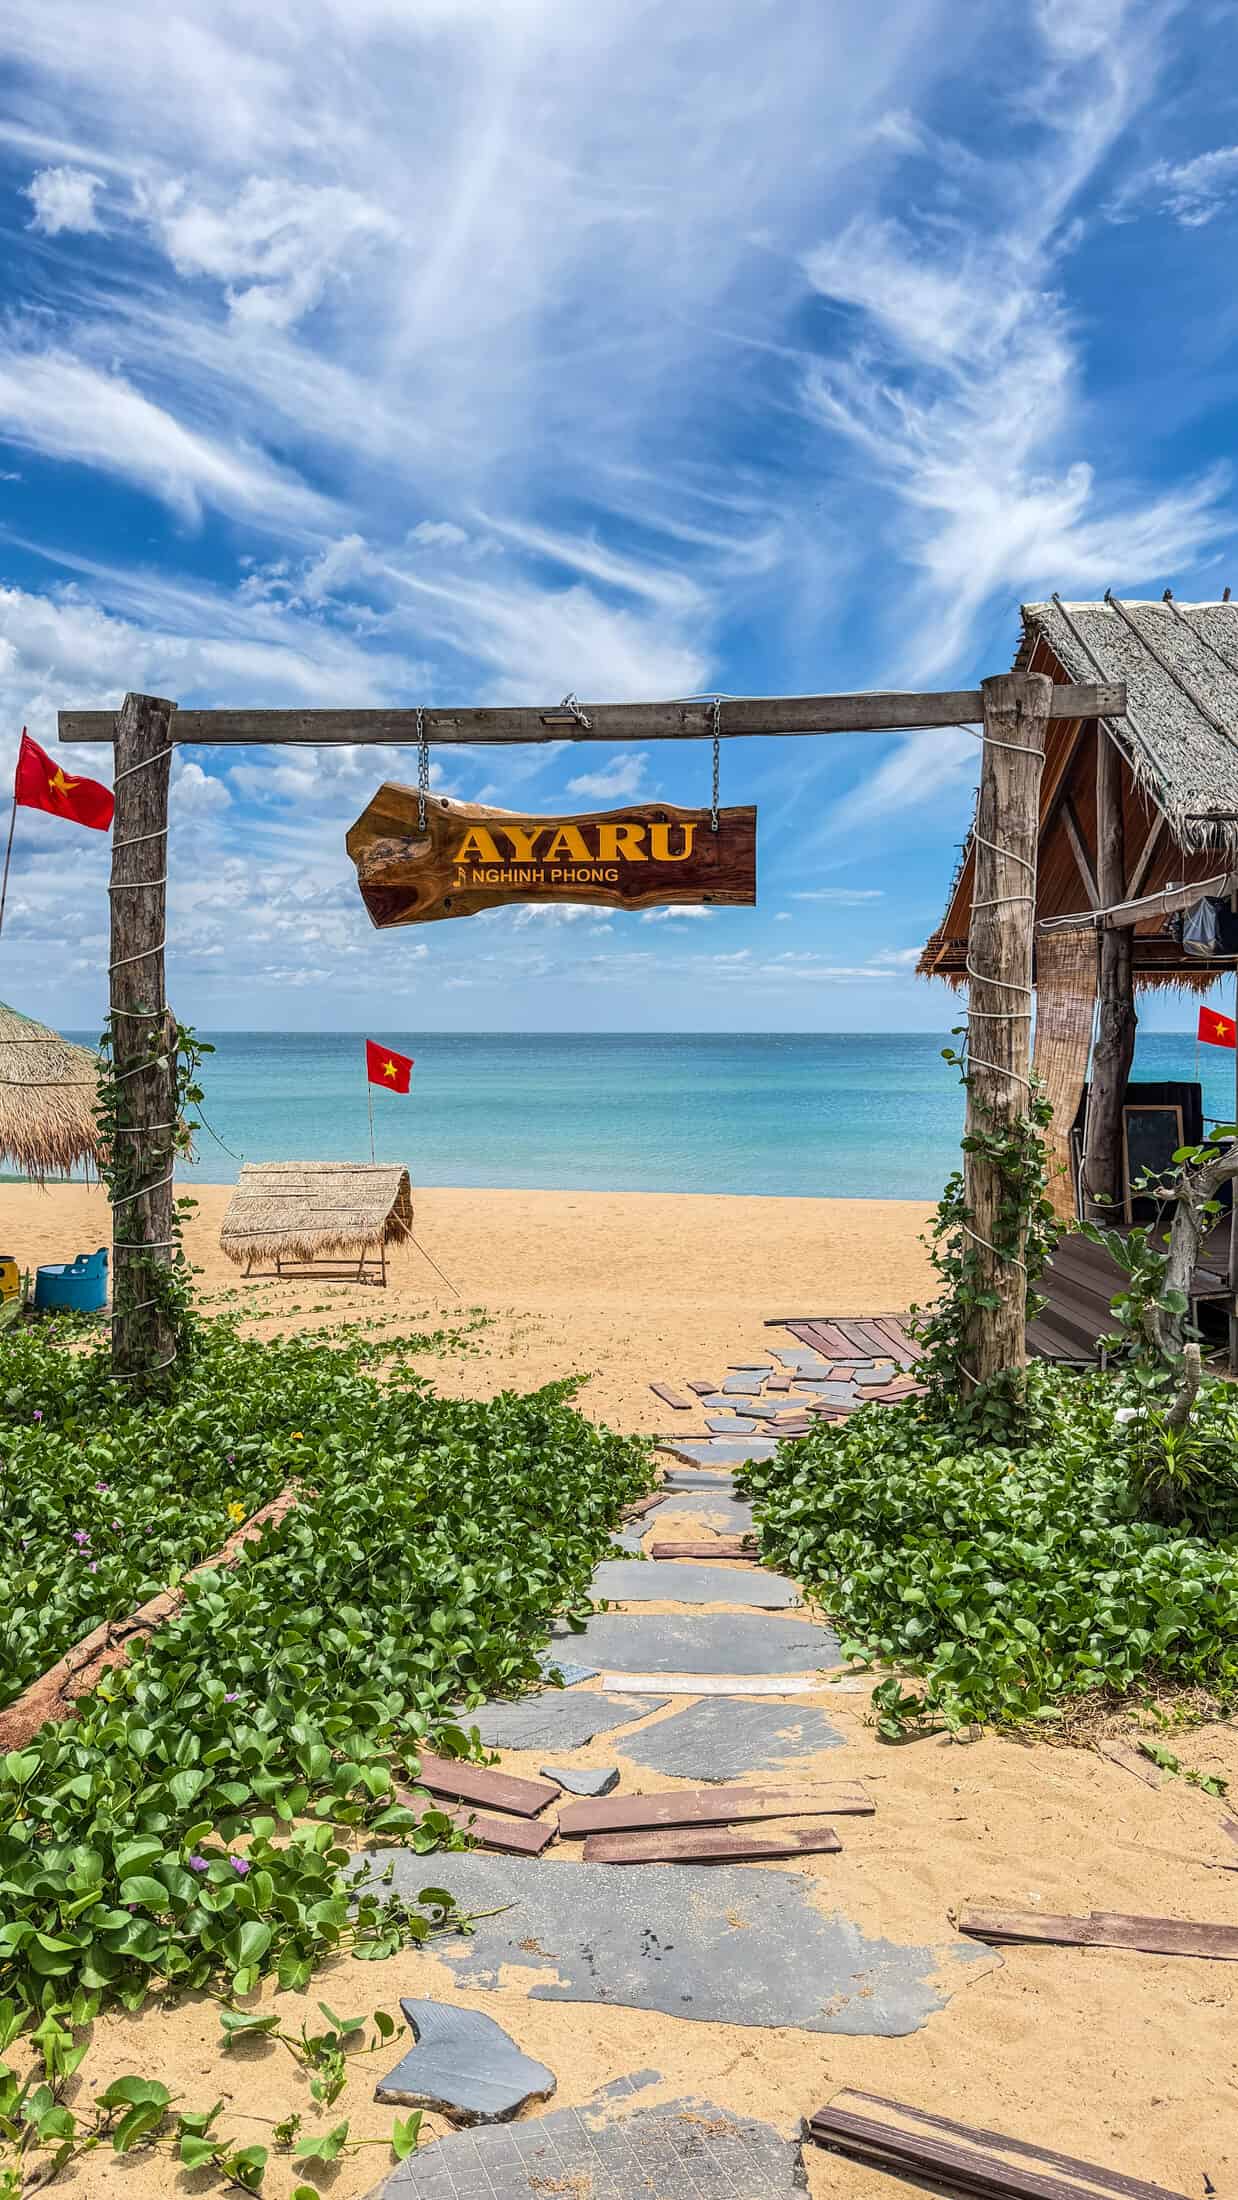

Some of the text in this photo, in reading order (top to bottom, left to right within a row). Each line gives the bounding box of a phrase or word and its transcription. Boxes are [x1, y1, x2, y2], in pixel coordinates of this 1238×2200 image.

[453, 823, 697, 862] AYARU
[472, 868, 619, 882] NGHINH PHONG
